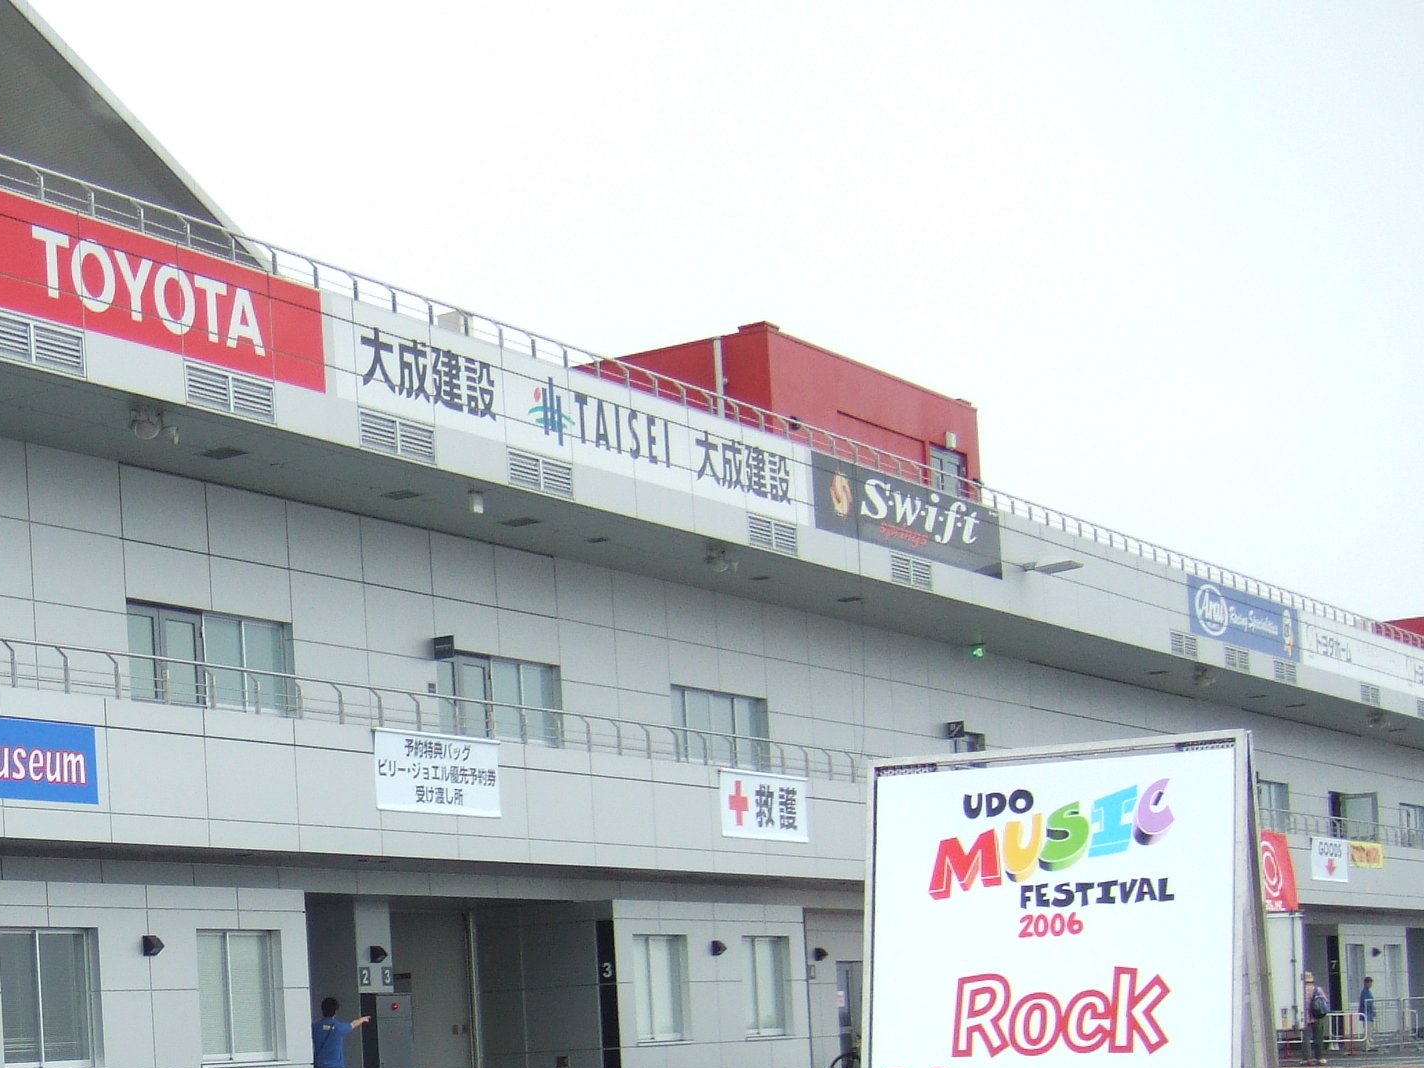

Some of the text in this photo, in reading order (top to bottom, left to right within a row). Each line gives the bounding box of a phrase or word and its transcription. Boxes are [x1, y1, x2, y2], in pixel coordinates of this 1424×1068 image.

[31, 224, 266, 357] TOYOTA
[360, 327, 497, 422] 大成建設
[574, 391, 670, 469] TAISEI
[695, 430, 792, 505] 大成建設
[754, 783, 799, 831] 救護
[962, 788, 1035, 820] UDO
[927, 777, 1176, 901] MUSIC
[1019, 877, 1176, 909] FESTIVAL
[1017, 911, 1085, 939] 2006
[362, 969, 392, 985] 2 3
[602, 962, 613, 978] 3
[951, 966, 1171, 1059] Rock
